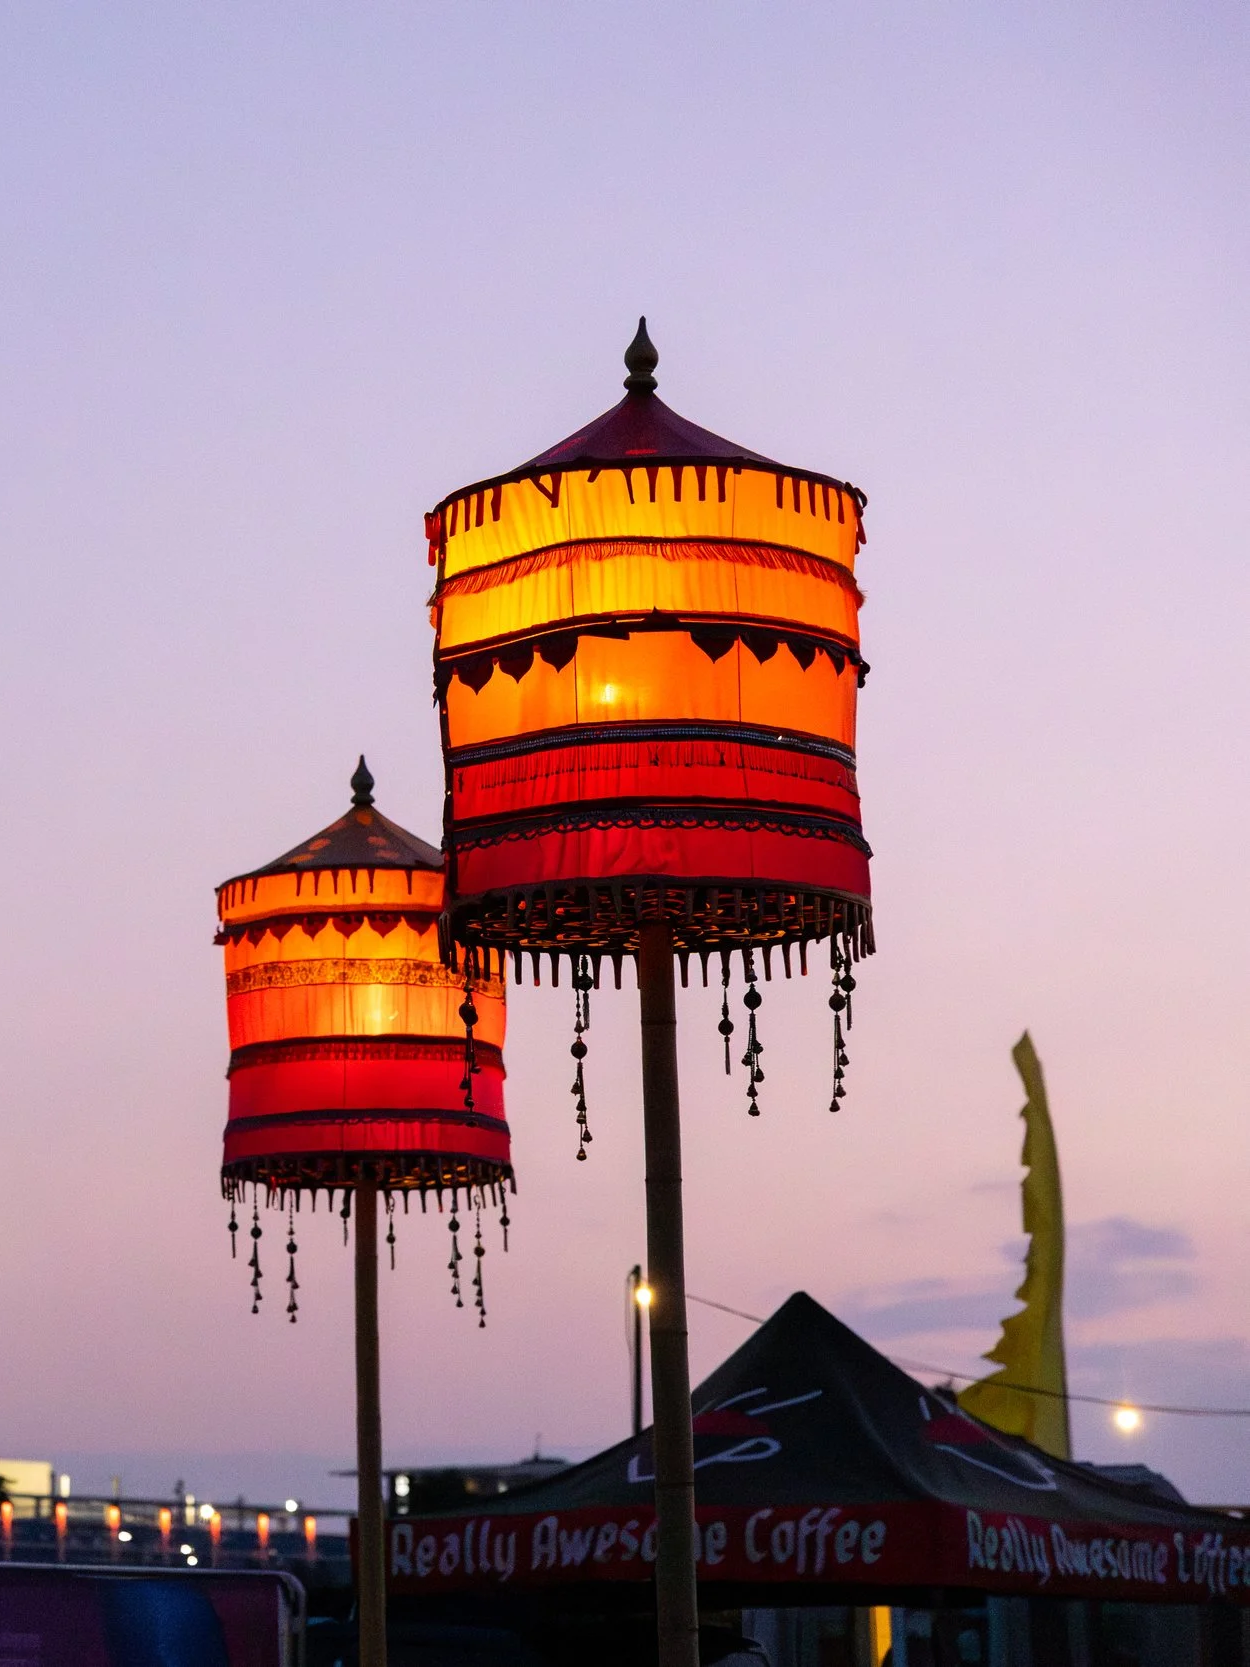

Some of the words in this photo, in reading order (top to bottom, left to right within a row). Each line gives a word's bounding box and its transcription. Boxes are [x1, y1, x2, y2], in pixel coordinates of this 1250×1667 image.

[390, 1522, 517, 1582] Really
[530, 1515, 727, 1571] Awesoe
[745, 1507, 888, 1575] Coffee
[966, 1509, 1050, 1586] Really
[1051, 1522, 1168, 1585] Awesome
